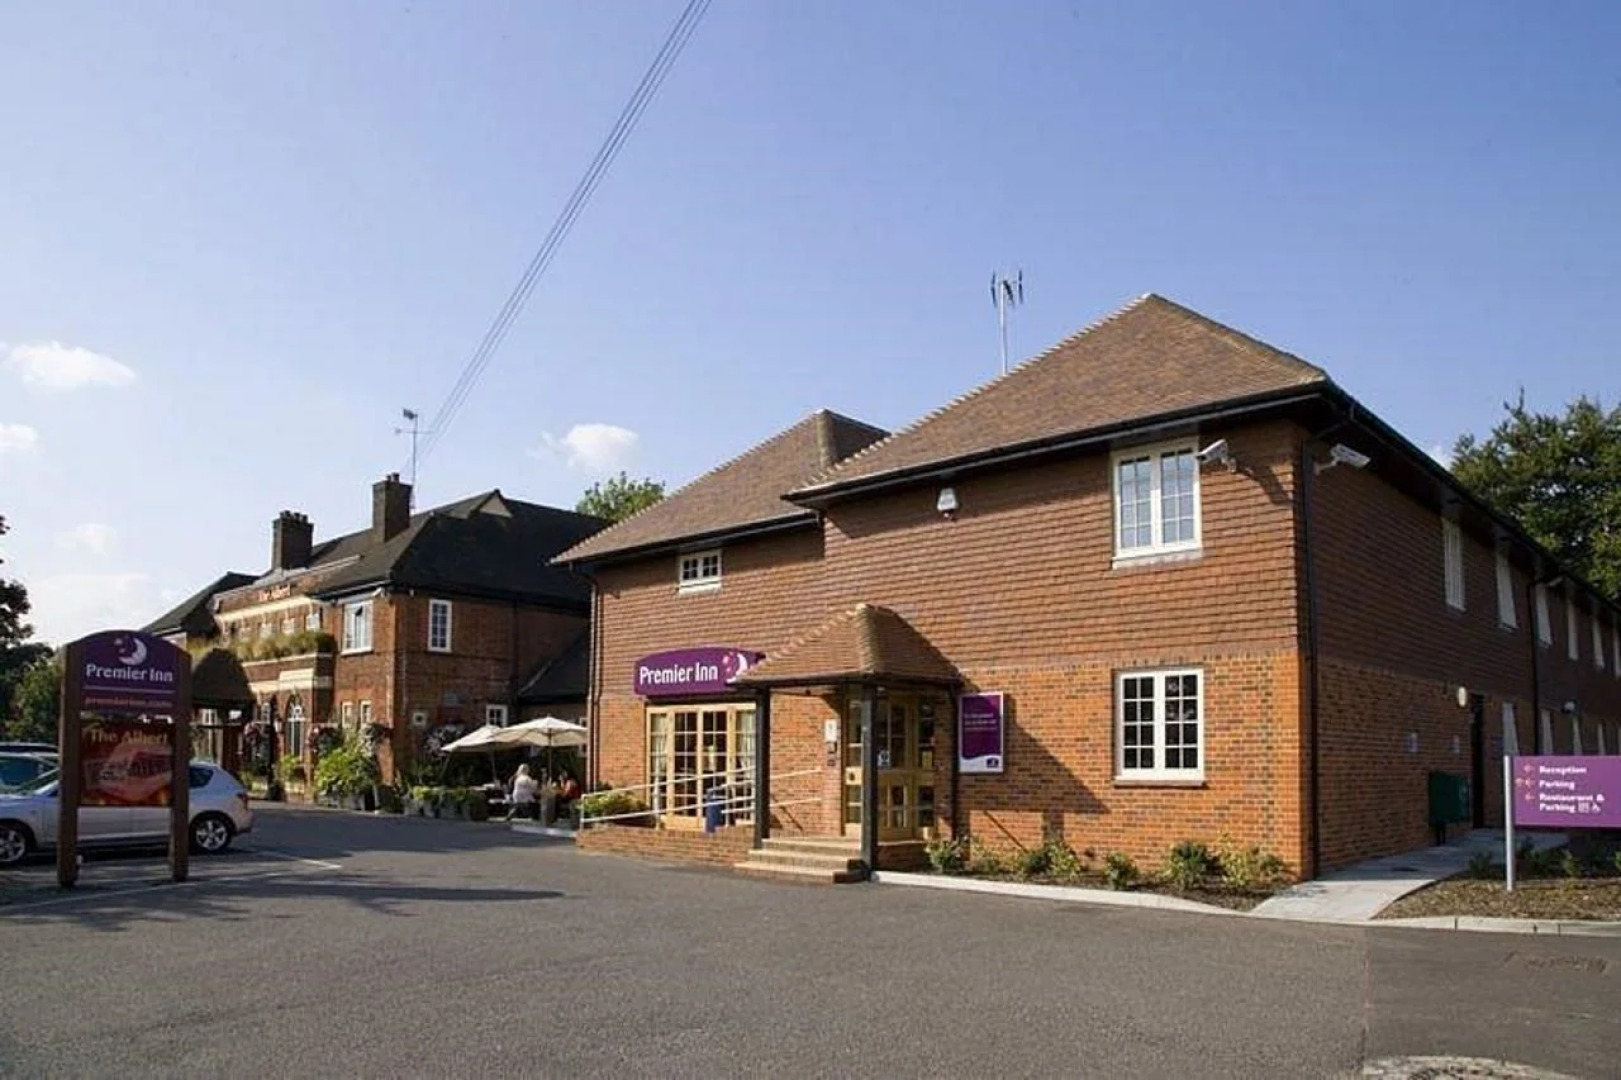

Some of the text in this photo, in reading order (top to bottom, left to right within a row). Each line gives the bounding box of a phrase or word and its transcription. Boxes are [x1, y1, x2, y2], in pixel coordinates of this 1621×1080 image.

[86, 663, 173, 681] Premier Inn
[639, 662, 718, 685] Premier Inn
[90, 727, 168, 744] The Albert
[1539, 766, 1587, 775] Reception
[1539, 780, 1575, 791] Parking
[1539, 803, 1576, 813] Parking
